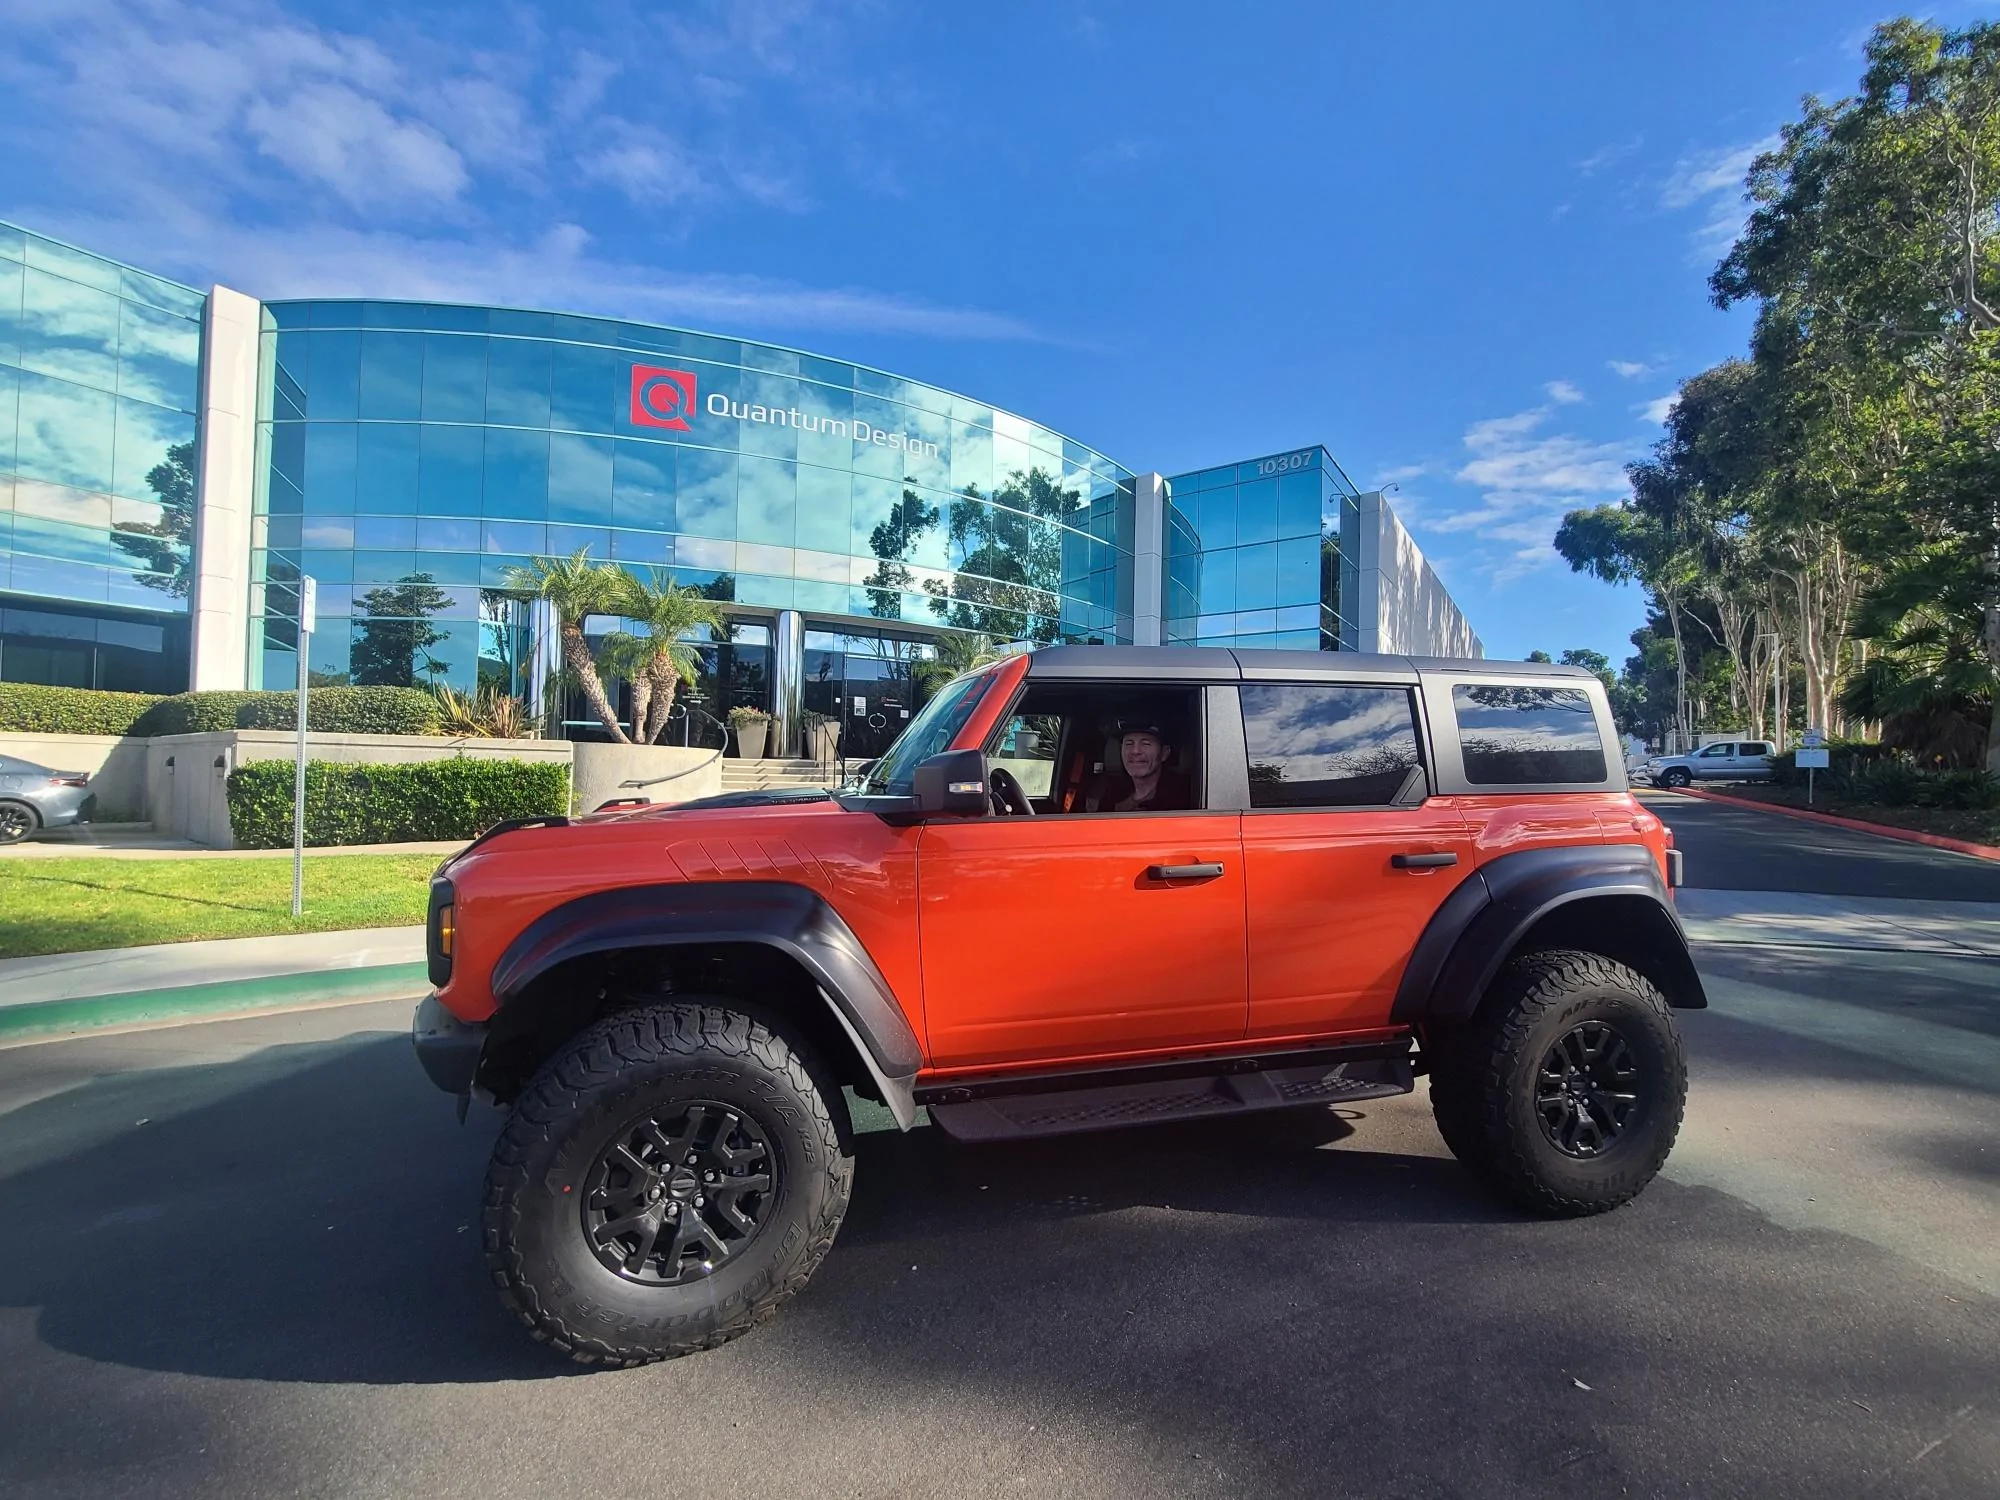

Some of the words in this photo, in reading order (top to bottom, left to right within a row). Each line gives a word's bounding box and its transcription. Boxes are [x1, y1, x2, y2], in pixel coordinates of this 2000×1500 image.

[706, 393, 846, 437] Quantum
[853, 419, 938, 459] Design
[1257, 452, 1313, 475] 10307
